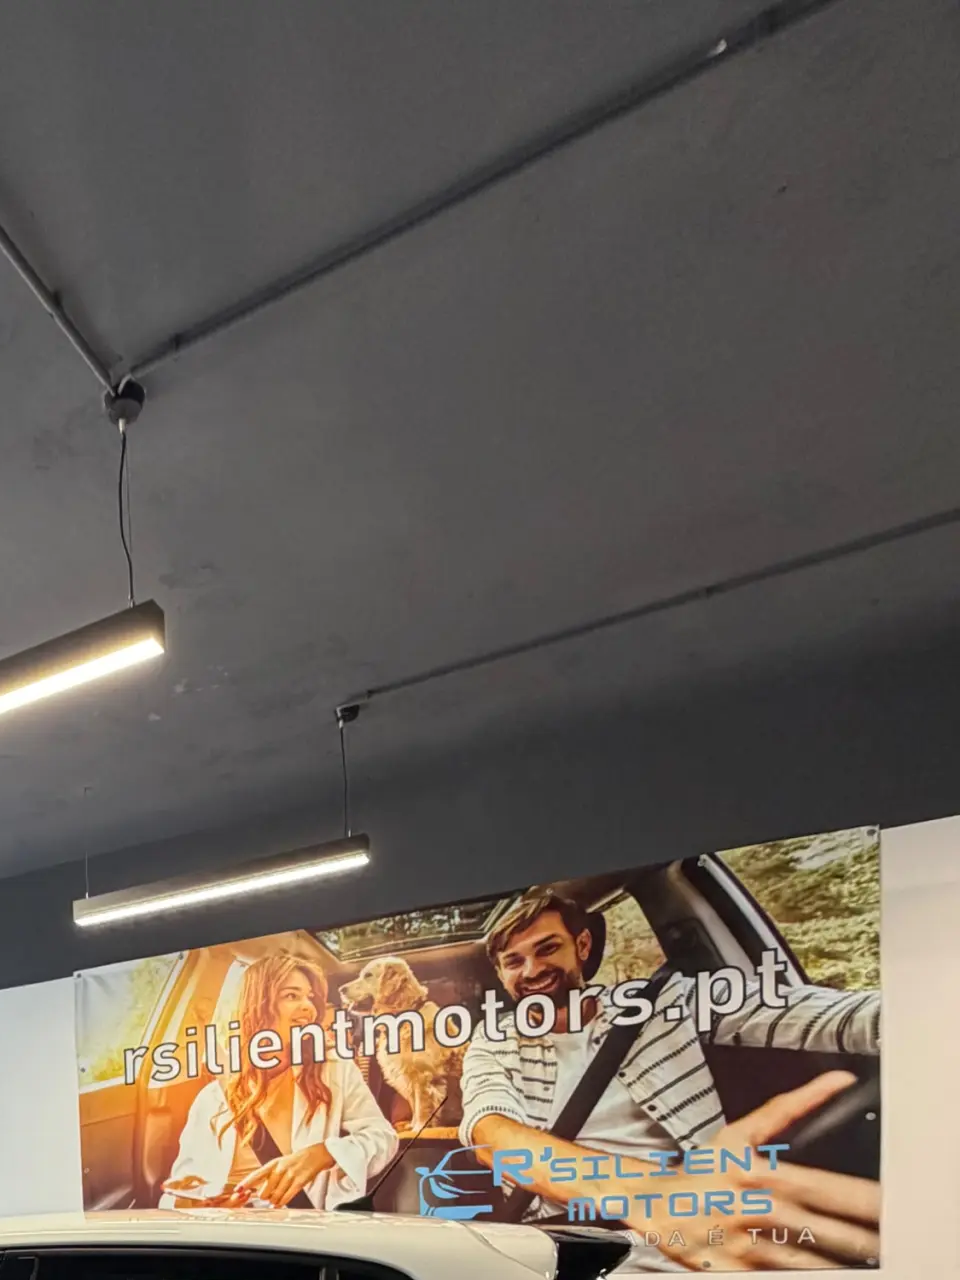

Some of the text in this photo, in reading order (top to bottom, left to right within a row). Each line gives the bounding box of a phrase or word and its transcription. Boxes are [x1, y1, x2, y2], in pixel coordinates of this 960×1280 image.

[123, 948, 788, 1086] rsilientmotors.pt
[492, 1144, 790, 1187] R'SILIENT
[568, 1189, 774, 1222] MOTORS
[708, 1224, 724, 1245] É
[747, 1226, 816, 1245] TUA
